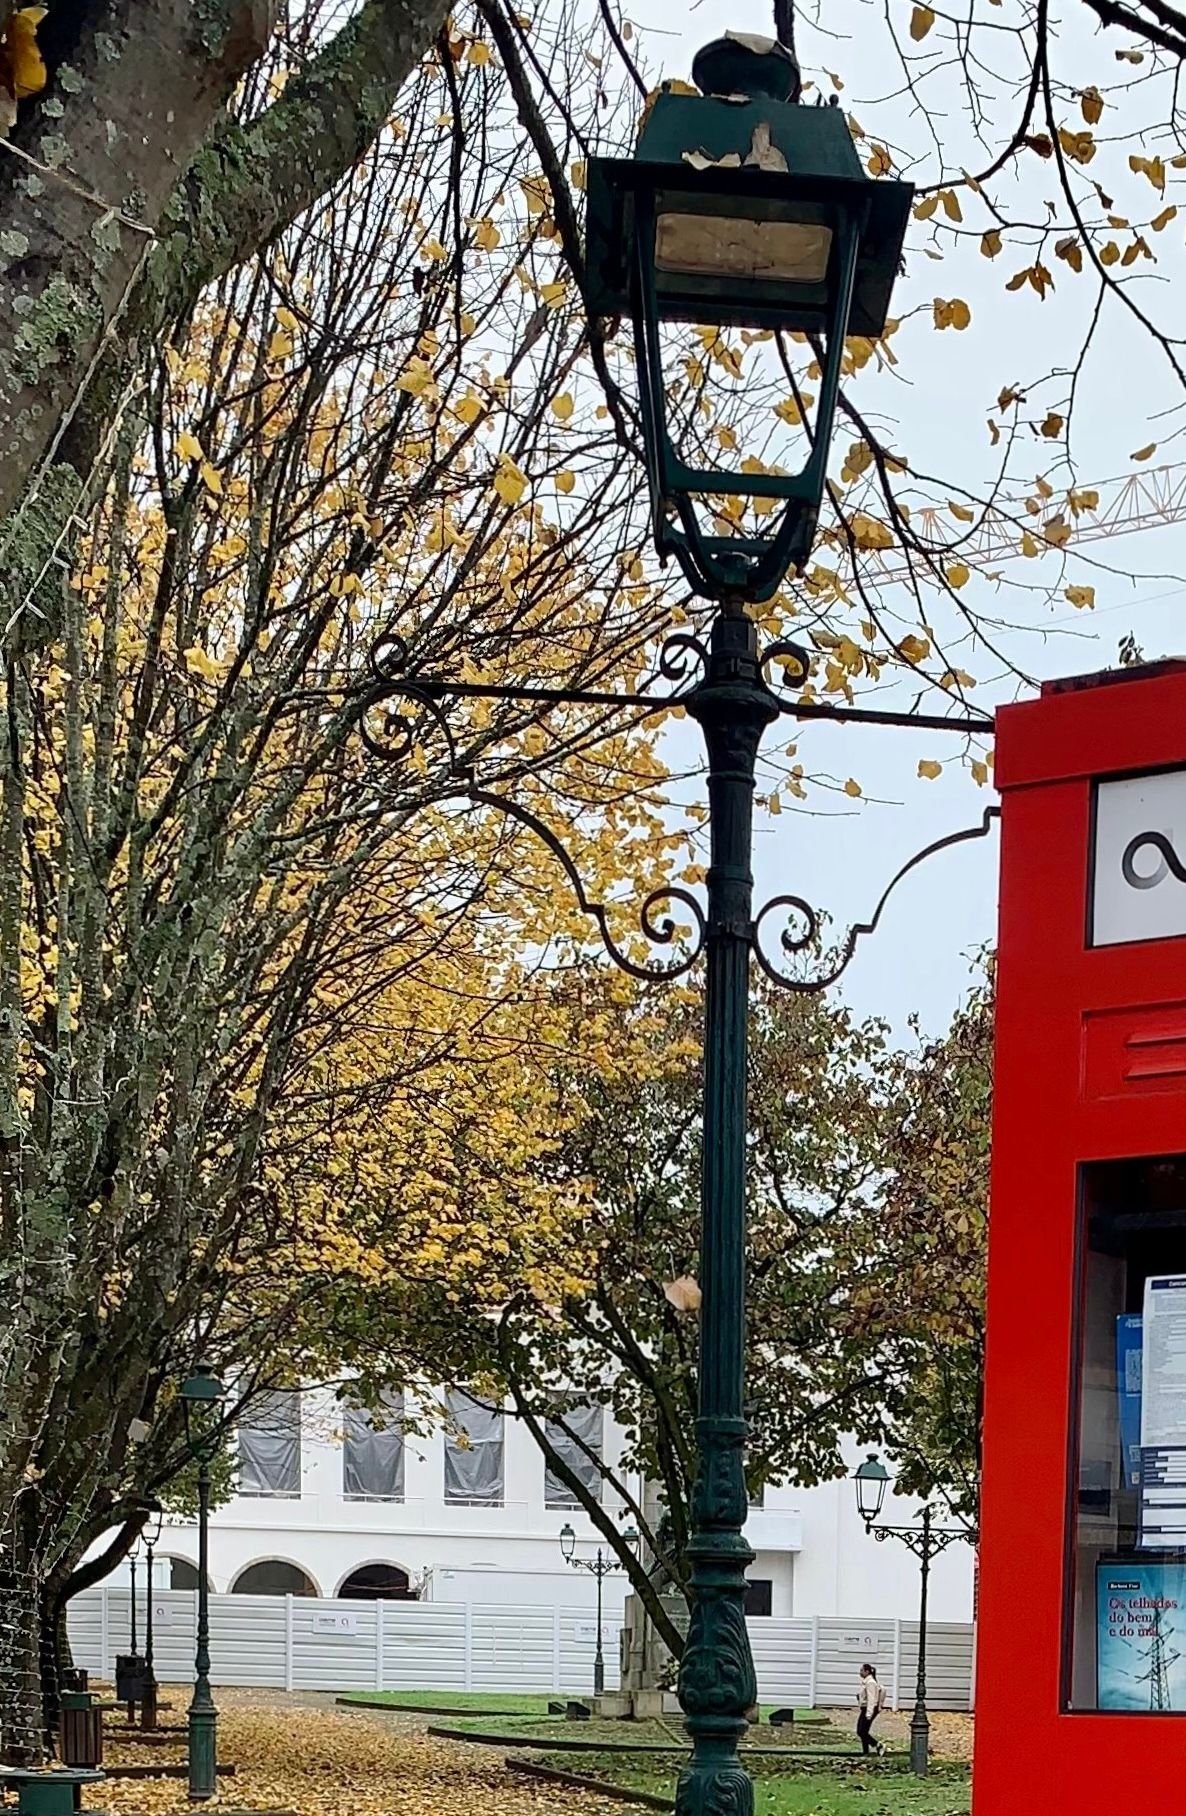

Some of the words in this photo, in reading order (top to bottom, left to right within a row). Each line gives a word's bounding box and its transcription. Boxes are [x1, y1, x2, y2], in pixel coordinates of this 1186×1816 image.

[1109, 1597, 1126, 1609] Os
[1128, 1596, 1178, 1609] telhados
[1109, 1611, 1124, 1623] do
[1127, 1611, 1152, 1623] bem
[1109, 1628, 1116, 1637] e
[1119, 1625, 1135, 1637] do
